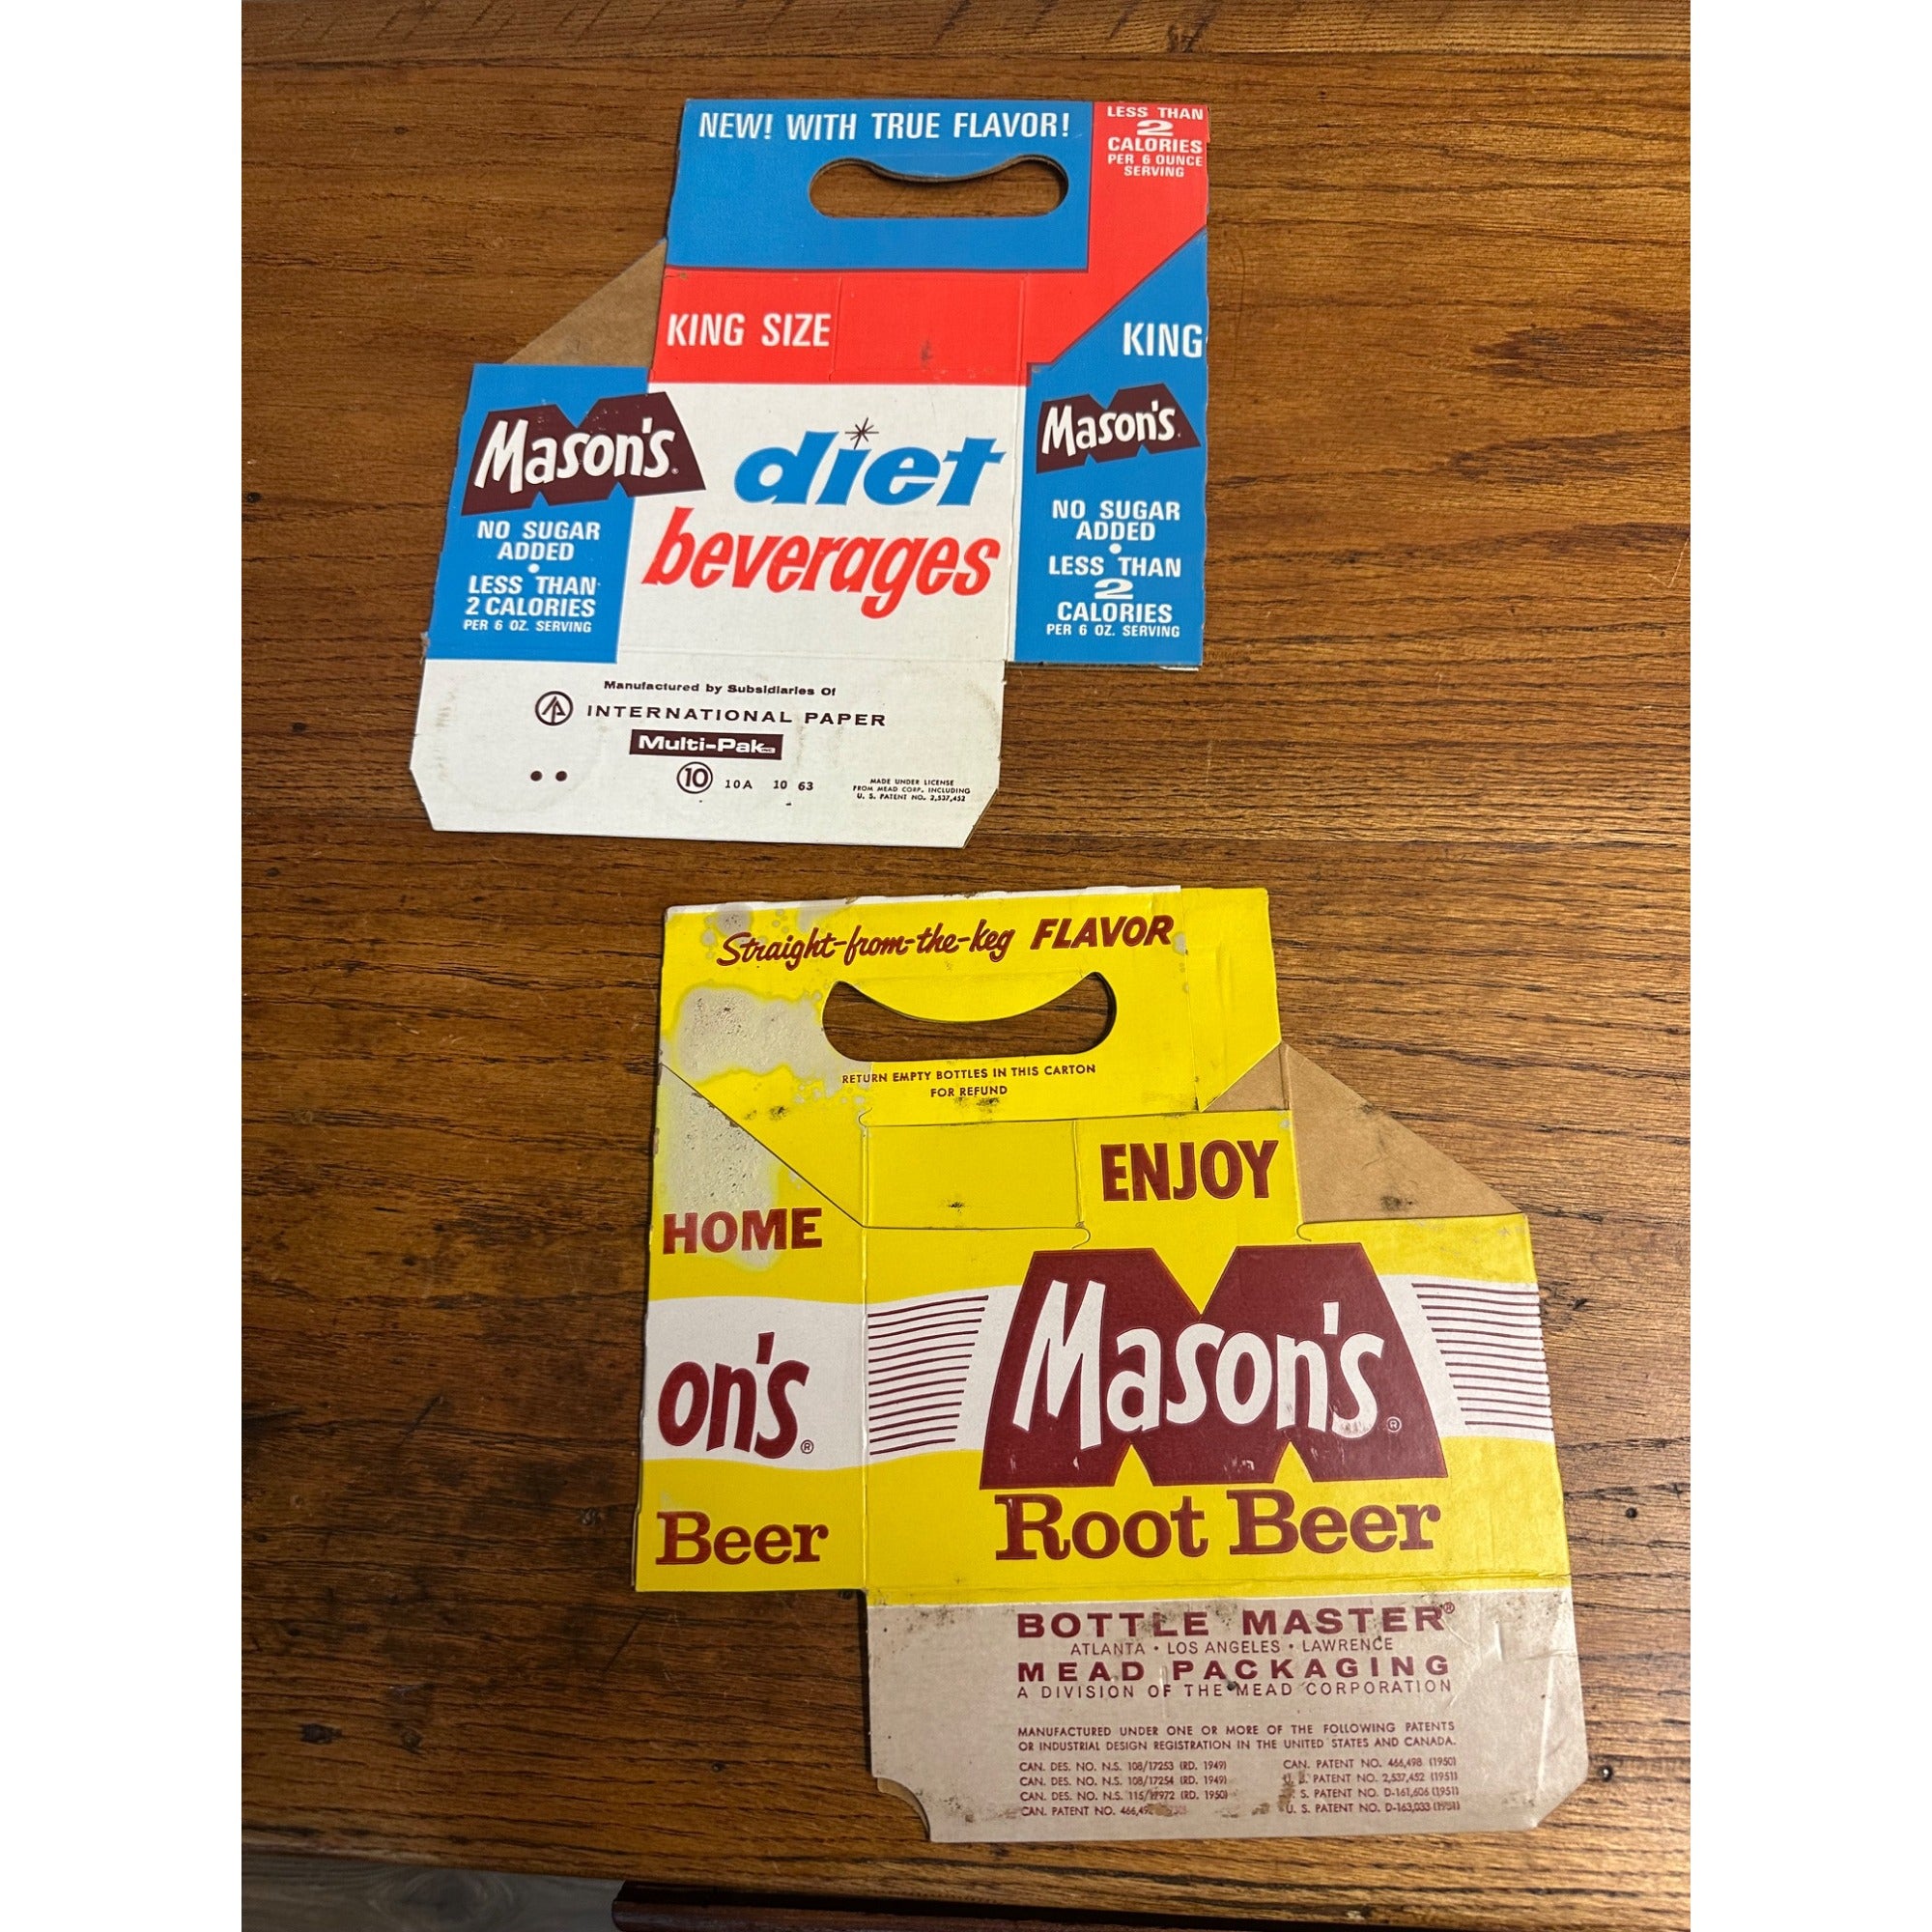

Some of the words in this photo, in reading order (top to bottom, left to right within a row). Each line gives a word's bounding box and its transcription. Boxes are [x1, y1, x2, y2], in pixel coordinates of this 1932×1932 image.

[1107, 105, 1149, 118] LESS
[1156, 106, 1204, 121] THAN
[699, 111, 773, 139] NEW!
[785, 112, 857, 140] WITH
[872, 111, 940, 139] TRUE
[953, 111, 1069, 138] FLAVOR!
[1136, 119, 1174, 137] 2
[1107, 136, 1203, 155] CALORIES
[1107, 154, 1134, 165] PER
[1142, 154, 1151, 165] 6
[1155, 155, 1204, 166] OUNCE
[1123, 165, 1184, 178] SERVING
[667, 312, 746, 347] KING
[761, 312, 831, 347] SIZE
[1122, 322, 1203, 358] KING
[1040, 400, 1176, 457] Mason's
[473, 416, 676, 495] Mason's
[734, 419, 1007, 507] diet
[1052, 499, 1086, 520] NO
[1099, 499, 1180, 521] SUGAR
[476, 520, 510, 540] NO
[523, 521, 601, 541] SUGAR
[1075, 521, 1155, 542] ADDED
[497, 541, 575, 561] ADDED
[641, 505, 1001, 619] beverages
[1048, 554, 1104, 577] LESS
[1118, 555, 1181, 578] THAN
[468, 575, 523, 595] LESS
[535, 576, 596, 596] THAN
[1094, 577, 1134, 601] 2
[464, 596, 481, 615] 2
[485, 597, 596, 617] CALORIES
[1057, 601, 1173, 624] CALORIES
[463, 619, 488, 631] PER
[494, 619, 503, 632] 6
[509, 619, 529, 632] OZ.
[535, 620, 592, 634] SERVING
[1046, 623, 1071, 637] PER
[1078, 623, 1088, 637] 6
[1094, 623, 1116, 637] OZ.
[1122, 624, 1180, 639] SERVING
[604, 680, 699, 693] Manufactured
[705, 683, 723, 695] by
[726, 684, 815, 696] Subsidiaries
[820, 686, 837, 696] Of
[586, 704, 793, 724] INTERNATIONAL
[804, 711, 886, 727] PAPER
[638, 734, 766, 754] Multi-Pak
[684, 767, 709, 788] 10
[724, 779, 753, 790] 10A
[773, 780, 787, 790] 10
[797, 781, 814, 791] 63
[929, 794, 966, 803] 2,537,452
[716, 919, 1015, 971] Straight-from-the-keg
[1029, 914, 1175, 951] FLAVOR
[841, 1072, 888, 1084] RETURN
[892, 1070, 931, 1083] EMPTY
[935, 1068, 988, 1080] BOTTLES
[992, 1067, 1008, 1078] IN
[1011, 1065, 1039, 1077] THIS
[1043, 1064, 1096, 1076] CARTON
[930, 1088, 955, 1097] FOR
[959, 1085, 1008, 1097] REFUND
[1100, 1139, 1279, 1203] ENJOY
[663, 1208, 822, 1254] HOME
[1012, 1279, 1384, 1451] Mason's
[994, 1492, 1208, 1561] Root
[1227, 1489, 1441, 1556] Beer
[655, 1510, 829, 1566] Beer
[1016, 1611, 1209, 1639] BOTTLE
[1242, 1605, 1445, 1636] MASTER
[1070, 1642, 1146, 1656] ATLANTA
[1167, 1641, 1199, 1655] LOS
[1205, 1639, 1281, 1655] ANGELES
[1302, 1636, 1394, 1652] LAWRENCE
[1017, 1661, 1146, 1683] MEAD
[1172, 1654, 1449, 1682] PACKAGING
[1016, 1687, 1029, 1698] A
[1041, 1684, 1135, 1699] DIVISION
[1148, 1684, 1172, 1698] OF
[1184, 1684, 1222, 1697] THE
[1236, 1682, 1293, 1697] MEAD
[1306, 1678, 1451, 1695] CORPORATION
[1017, 1726, 1111, 1737] MANUFACTURED
[1119, 1725, 1159, 1736] UNDER
[1166, 1725, 1193, 1736] ONE
[1201, 1725, 1218, 1736] OR
[1225, 1724, 1259, 1736] MORE
[1266, 1724, 1283, 1735] OF
[1291, 1723, 1313, 1735] THE
[1322, 1722, 1396, 1734] FOLLOWING
[1405, 1720, 1455, 1732] PATENTS
[1018, 1741, 1035, 1751] OR
[1038, 1741, 1100, 1751] INDUSTRIAL
[1106, 1741, 1148, 1750] DESIGN
[1153, 1740, 1232, 1750] REGISTRATION
[1236, 1739, 1250, 1749] IN
[1257, 1739, 1277, 1749] THE
[1283, 1738, 1324, 1749] UNITED
[1331, 1738, 1369, 1748] STATES
[1374, 1737, 1399, 1747] AND
[1404, 1736, 1457, 1747] CANADA.
[1019, 1761, 1046, 1772] CAN.
[1050, 1761, 1071, 1772] DES.
[1076, 1761, 1097, 1772] NO.
[1101, 1761, 1122, 1772] N.S.
[1127, 1760, 1174, 1773] 108/17253
[1179, 1760, 1198, 1772] (RD.
[1204, 1760, 1227, 1771] 1949)
[1282, 1759, 1310, 1770] CAN.
[1316, 1758, 1354, 1769] PATENT
[1360, 1758, 1382, 1769] NO.
[1387, 1757, 1423, 1769] 466,498
[1429, 1755, 1457, 1767] (1950)
[1019, 1776, 1046, 1787] CAN.
[1051, 1776, 1072, 1786] DES.
[1076, 1776, 1097, 1787] NO.
[1102, 1776, 1122, 1787] N.S.
[1127, 1776, 1175, 1788] 108/17254
[1179, 1775, 1199, 1786] (RD.
[1204, 1775, 1227, 1785] 1949)
[1313, 1774, 1351, 1783] PATENT
[1356, 1773, 1378, 1783] NO.
[1381, 1772, 1425, 1783] 2,537,452
[1430, 1771, 1458, 1781] (1951)
[1020, 1791, 1047, 1802] CAN.
[1051, 1791, 1072, 1802] DES.
[1077, 1791, 1098, 1802] NO.
[1103, 1790, 1123, 1802] N.S.
[1180, 1790, 1200, 1801] (RD.
[1205, 1789, 1229, 1800] 1950)
[1300, 1788, 1310, 1799] S.
[1314, 1788, 1352, 1798] PATENT
[1357, 1787, 1379, 1798] NO.
[1383, 1786, 1430, 1798] D-161,606
[1432, 1785, 1460, 1797] (1951)
[1020, 1806, 1047, 1816] CAN.
[1051, 1805, 1089, 1816] PATENT
[1094, 1805, 1116, 1816] NO.
[1120, 1805, 1156, 1816] 466,49
[1286, 1804, 1297, 1814] U.
[1301, 1804, 1311, 1814] S.
[1315, 1803, 1353, 1813] PATENT
[1358, 1803, 1381, 1813] NO.
[1384, 1802, 1431, 1813] D-163,033
